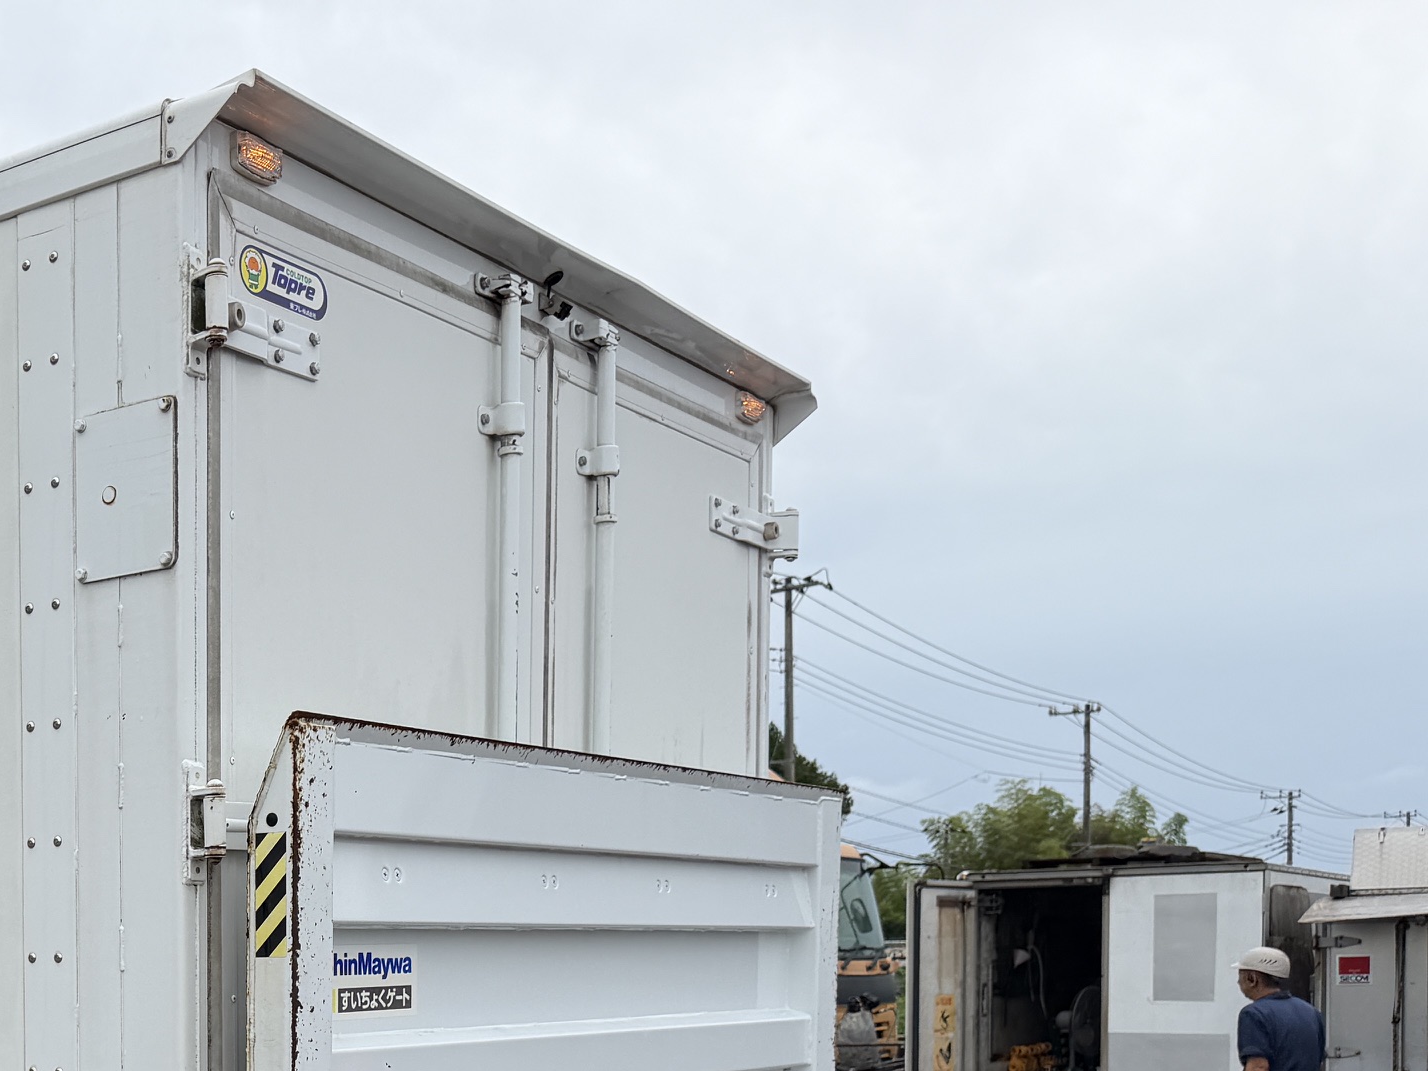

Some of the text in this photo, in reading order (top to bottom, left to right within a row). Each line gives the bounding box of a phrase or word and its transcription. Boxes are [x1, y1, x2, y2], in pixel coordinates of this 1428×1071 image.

[271, 262, 316, 301] Topre
[333, 952, 412, 980] hinMaywa
[340, 988, 410, 1011] すいちょくゲート
